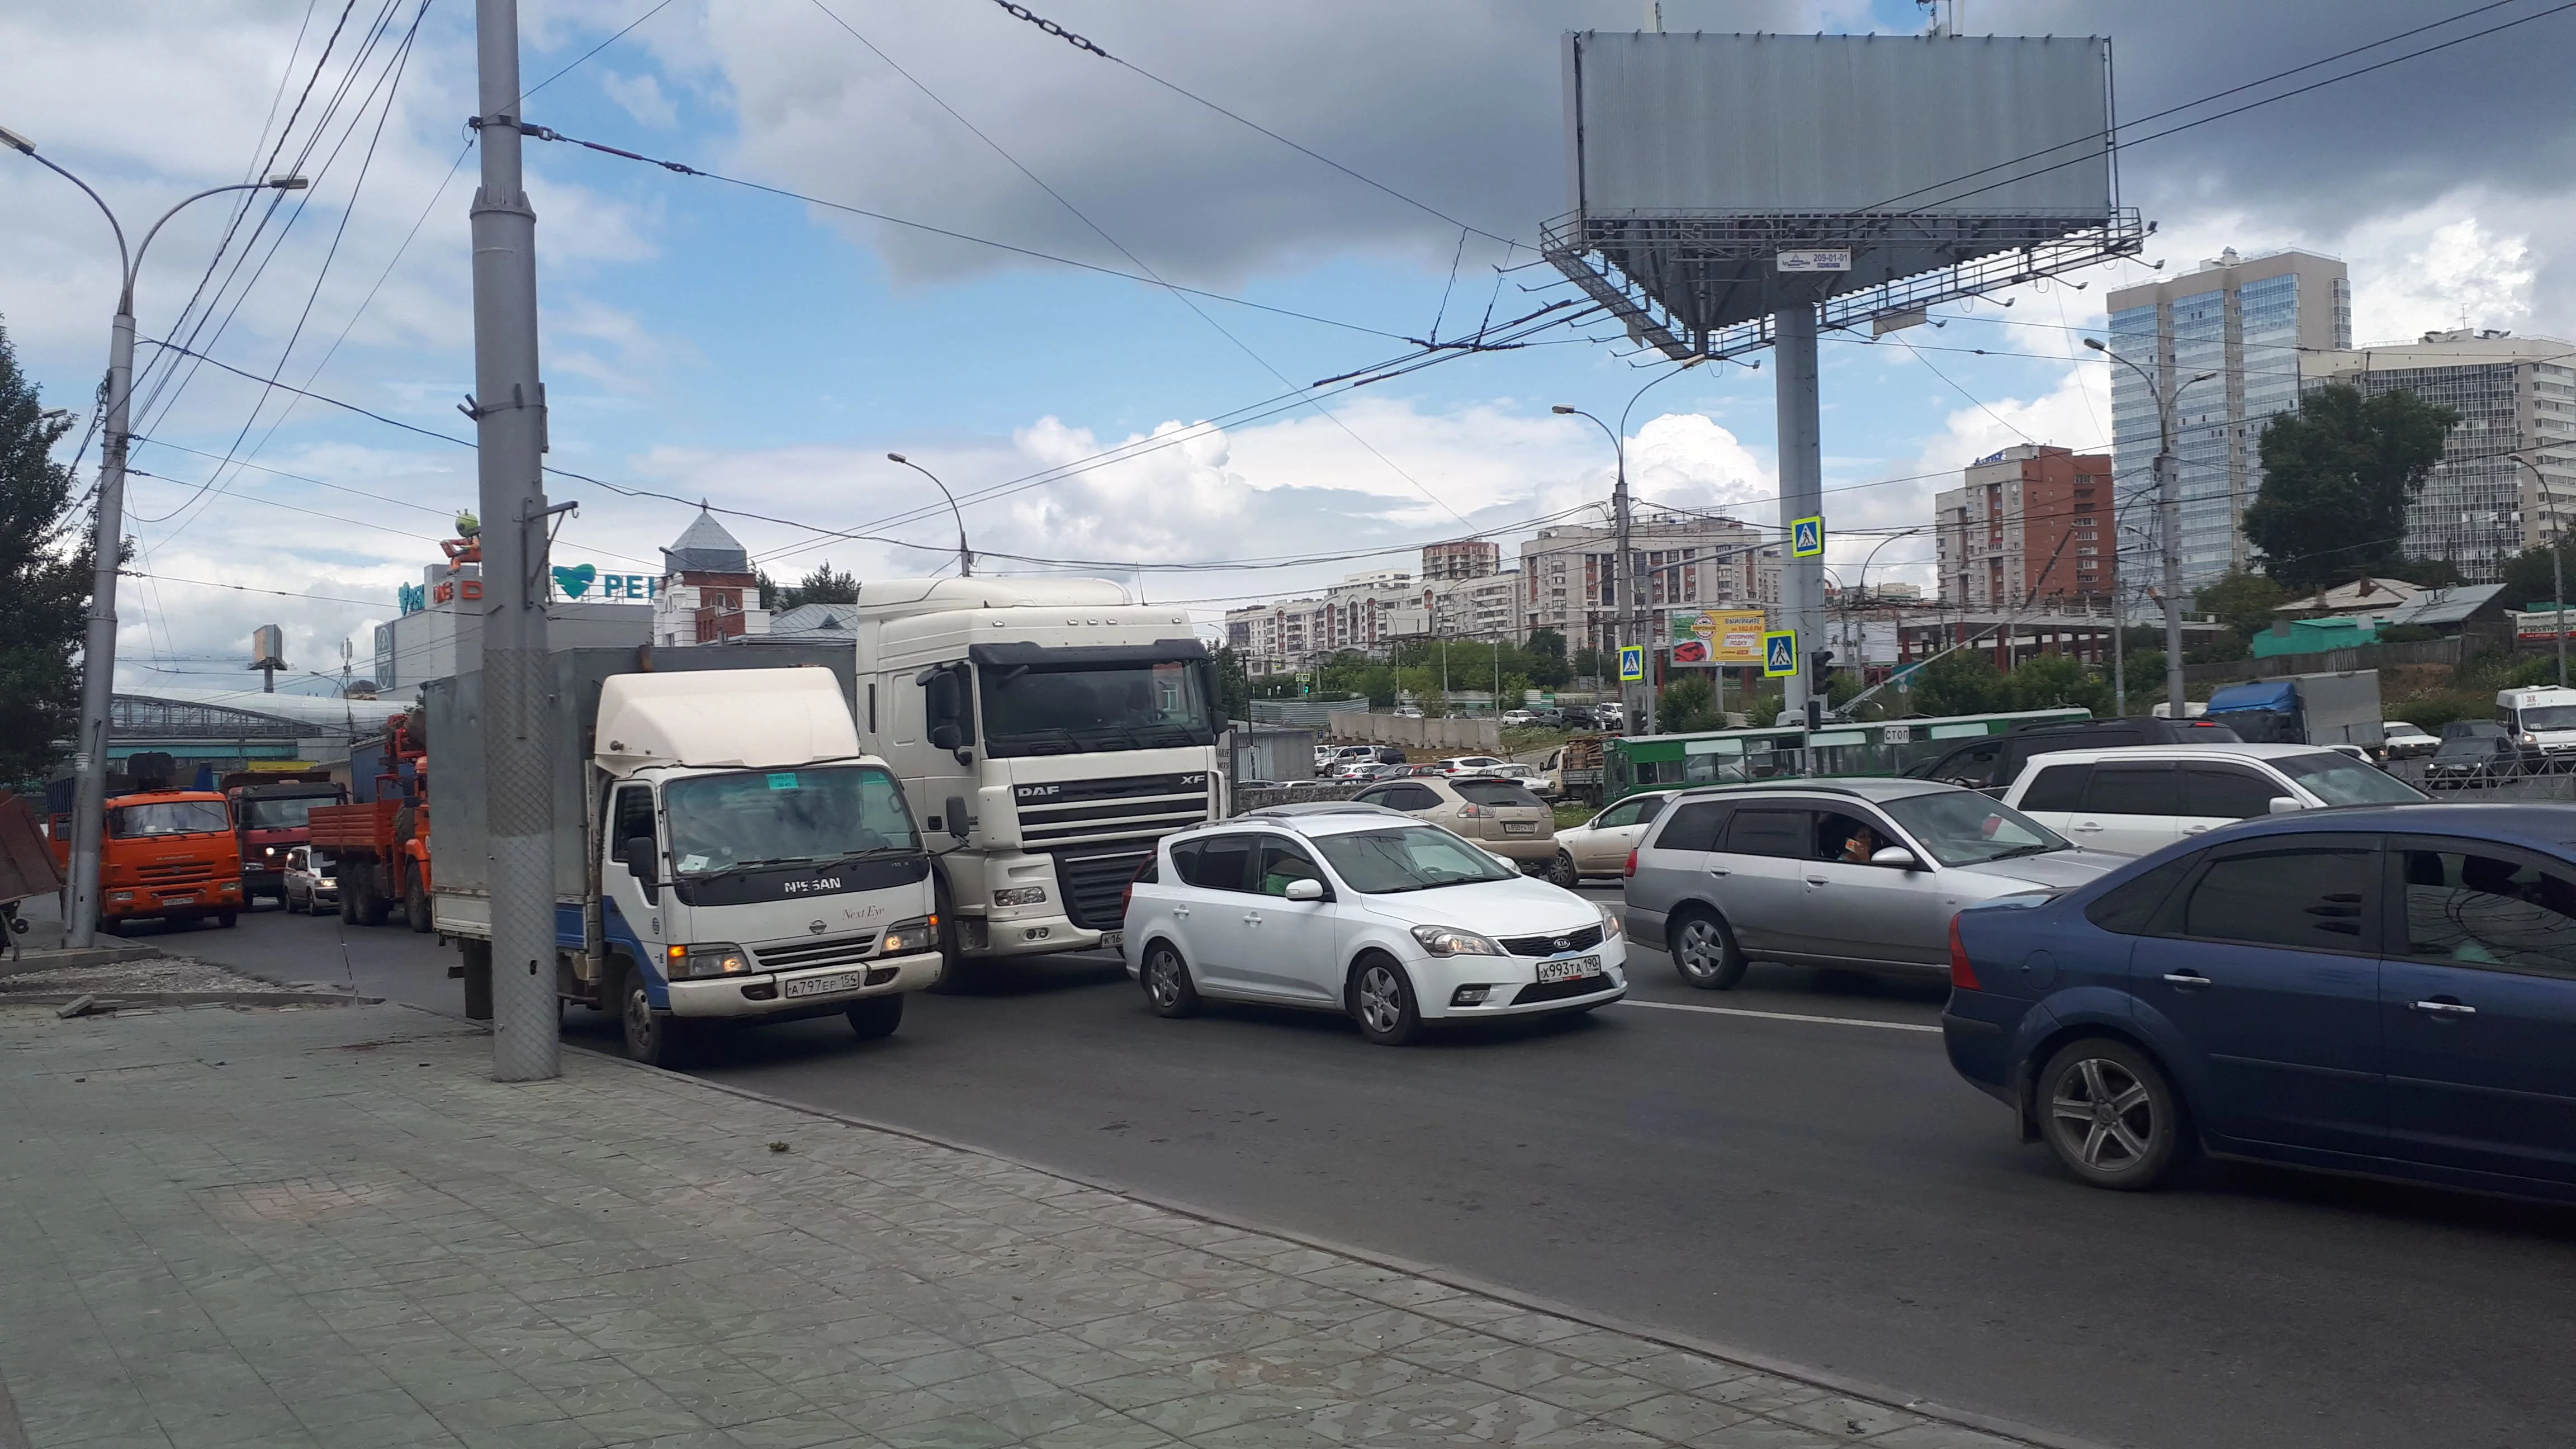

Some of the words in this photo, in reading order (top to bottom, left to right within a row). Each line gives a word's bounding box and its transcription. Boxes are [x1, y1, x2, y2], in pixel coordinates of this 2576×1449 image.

[1886, 730, 1908, 740] СТОП
[1216, 749, 1230, 757] ARIE
[1181, 775, 1205, 785] XF
[1018, 785, 1059, 797] DAF
[784, 877, 841, 893] NISSAN
[842, 908, 865, 921] Next
[1105, 934, 1123, 944] К16
[840, 974, 857, 985] 154
